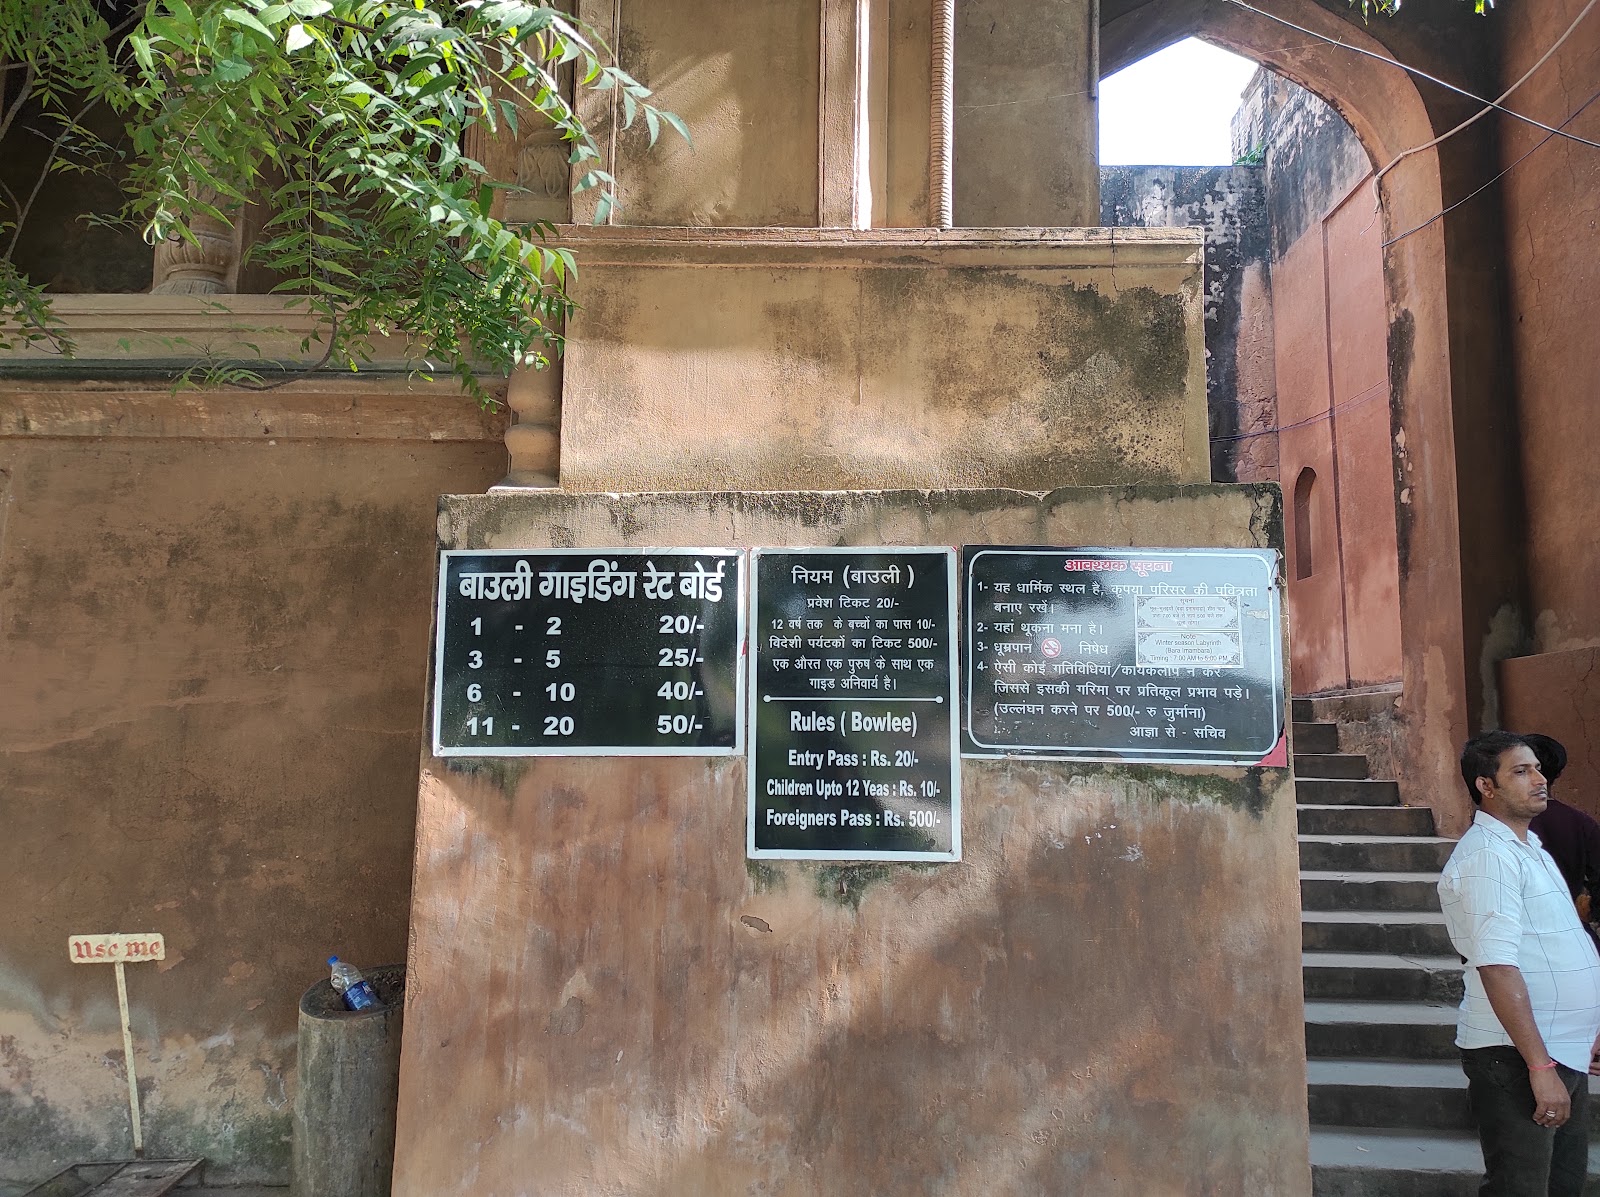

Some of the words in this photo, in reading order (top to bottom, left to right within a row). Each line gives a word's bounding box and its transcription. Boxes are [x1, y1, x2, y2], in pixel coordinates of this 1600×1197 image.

[791, 565, 833, 584] नियम
[1064, 559, 1127, 571] आवश्यक
[1130, 560, 1173, 577] सूचना
[459, 560, 533, 601] बाउली
[538, 559, 637, 604] गाइडिंग
[643, 561, 675, 601] रेट
[679, 559, 725, 602] बोर्ड
[977, 582, 988, 591] 1-
[994, 583, 1010, 593] यह
[1016, 580, 1053, 593] धार्मिक
[1059, 584, 1085, 594] स्थल
[1111, 585, 1143, 598] कृपया
[1150, 582, 1186, 595] परिसर
[1193, 582, 1208, 595] की
[1215, 583, 1258, 597] पवित्रता
[807, 595, 833, 609] प्रवेश
[839, 595, 870, 608] टिकट
[876, 597, 899, 609] 20/-
[994, 602, 1022, 615] बनाए
[470, 617, 482, 635] 1
[546, 617, 562, 635] 2
[659, 615, 704, 635] 20/-
[771, 618, 783, 630] 12
[788, 616, 801, 630] वर्ष
[807, 619, 823, 630] तक
[833, 616, 843, 630] के
[848, 616, 870, 630] बच्चों
[876, 619, 888, 630] का
[893, 619, 911, 630] पास
[917, 618, 936, 630] 10/-
[977, 623, 988, 632] 2-
[994, 619, 1014, 632] यहां
[1021, 623, 1053, 636] थूकना
[1060, 624, 1081, 634] मना
[769, 635, 802, 649] विदेशी
[808, 635, 845, 649] पर्यटकों
[852, 638, 865, 649] का
[872, 636, 901, 649] टिकट
[907, 638, 938, 650] 500/-
[977, 642, 988, 651] 3-
[994, 642, 1032, 656] धूम्रपान
[1079, 641, 1108, 654] निषेध
[468, 650, 483, 669] 3
[545, 649, 560, 668] 5
[658, 648, 704, 667] 25/-
[772, 658, 789, 672] एक
[794, 655, 821, 670] औरत
[826, 658, 843, 672] एक
[848, 658, 870, 674] पुरुष
[874, 655, 886, 670] के
[891, 659, 912, 670] साथ
[917, 659, 934, 672] एक
[976, 662, 988, 671] 4-
[994, 659, 1016, 674] ऐसी
[1022, 660, 1046, 675] कोई
[467, 683, 482, 702] 6
[545, 683, 576, 701] 10
[657, 681, 703, 701] 40/-
[809, 677, 835, 691] गाइड
[840, 675, 878, 689] अनिवार्य
[994, 680, 1030, 694] जिससे
[1036, 681, 1070, 695] इसकी
[1076, 682, 1109, 695] गरिमा
[1115, 686, 1131, 696] पर
[1137, 683, 1181, 700] प्रतिकूल
[1187, 687, 1217, 698] प्रभाव
[994, 700, 1044, 716] (उल्लंघन
[1050, 702, 1078, 716] करने
[1084, 705, 1100, 716] पर
[1106, 705, 1140, 717] 500/-
[1146, 707, 1157, 717] रु
[1163, 704, 1206, 721] जुर्माना)
[466, 716, 493, 735] 11
[543, 716, 575, 735] 20
[657, 715, 703, 734] 50/-
[790, 711, 836, 732] Rules
[1129, 726, 1159, 739] आज्ञा
[1165, 724, 1176, 738] से
[1193, 727, 1226, 739] सचिव
[788, 750, 824, 770] Entry
[828, 750, 859, 766] Pass
[870, 750, 891, 766] Rs.
[895, 750, 918, 767] 20/-
[766, 779, 812, 796] Children
[816, 779, 843, 799] Upto
[846, 779, 859, 796] 12
[862, 780, 889, 796] Yeas
[899, 780, 917, 796] Rs.
[920, 780, 940, 797] 10/-
[766, 809, 836, 830] Foreigners
[840, 809, 872, 826] Pass
[884, 810, 904, 827] Rs.
[909, 810, 941, 827] 500/-
[125, 941, 161, 957] me
